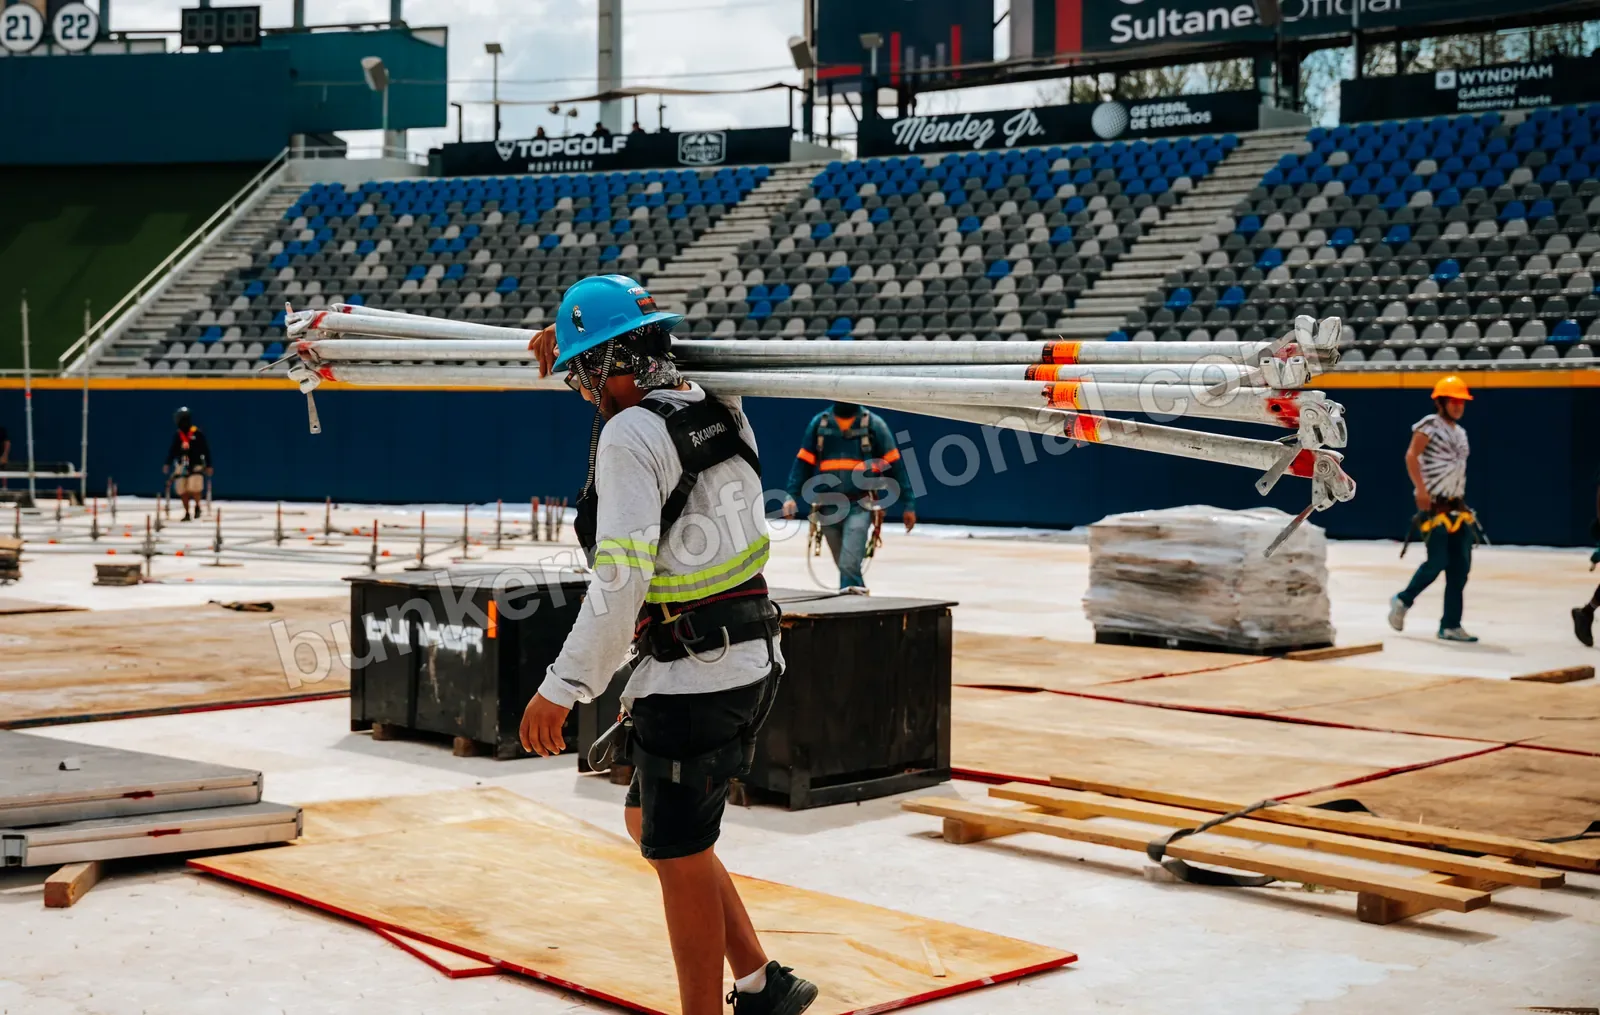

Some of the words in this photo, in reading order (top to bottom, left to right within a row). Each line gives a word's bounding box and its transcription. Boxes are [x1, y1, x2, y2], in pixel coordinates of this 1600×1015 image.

[6, 15, 34, 40] 21
[61, 14, 90, 40] 22
[1458, 63, 1554, 85] WYNDHAM
[1458, 84, 1516, 99] GARDEN
[1518, 94, 1552, 106] Norte
[1130, 101, 1191, 118] GENERAL
[1130, 118, 1149, 130] DE
[1150, 110, 1213, 129] SEGUROS
[891, 113, 996, 152] Méndez
[1002, 108, 1046, 148] Jr.
[516, 135, 628, 158] TOPGOLF
